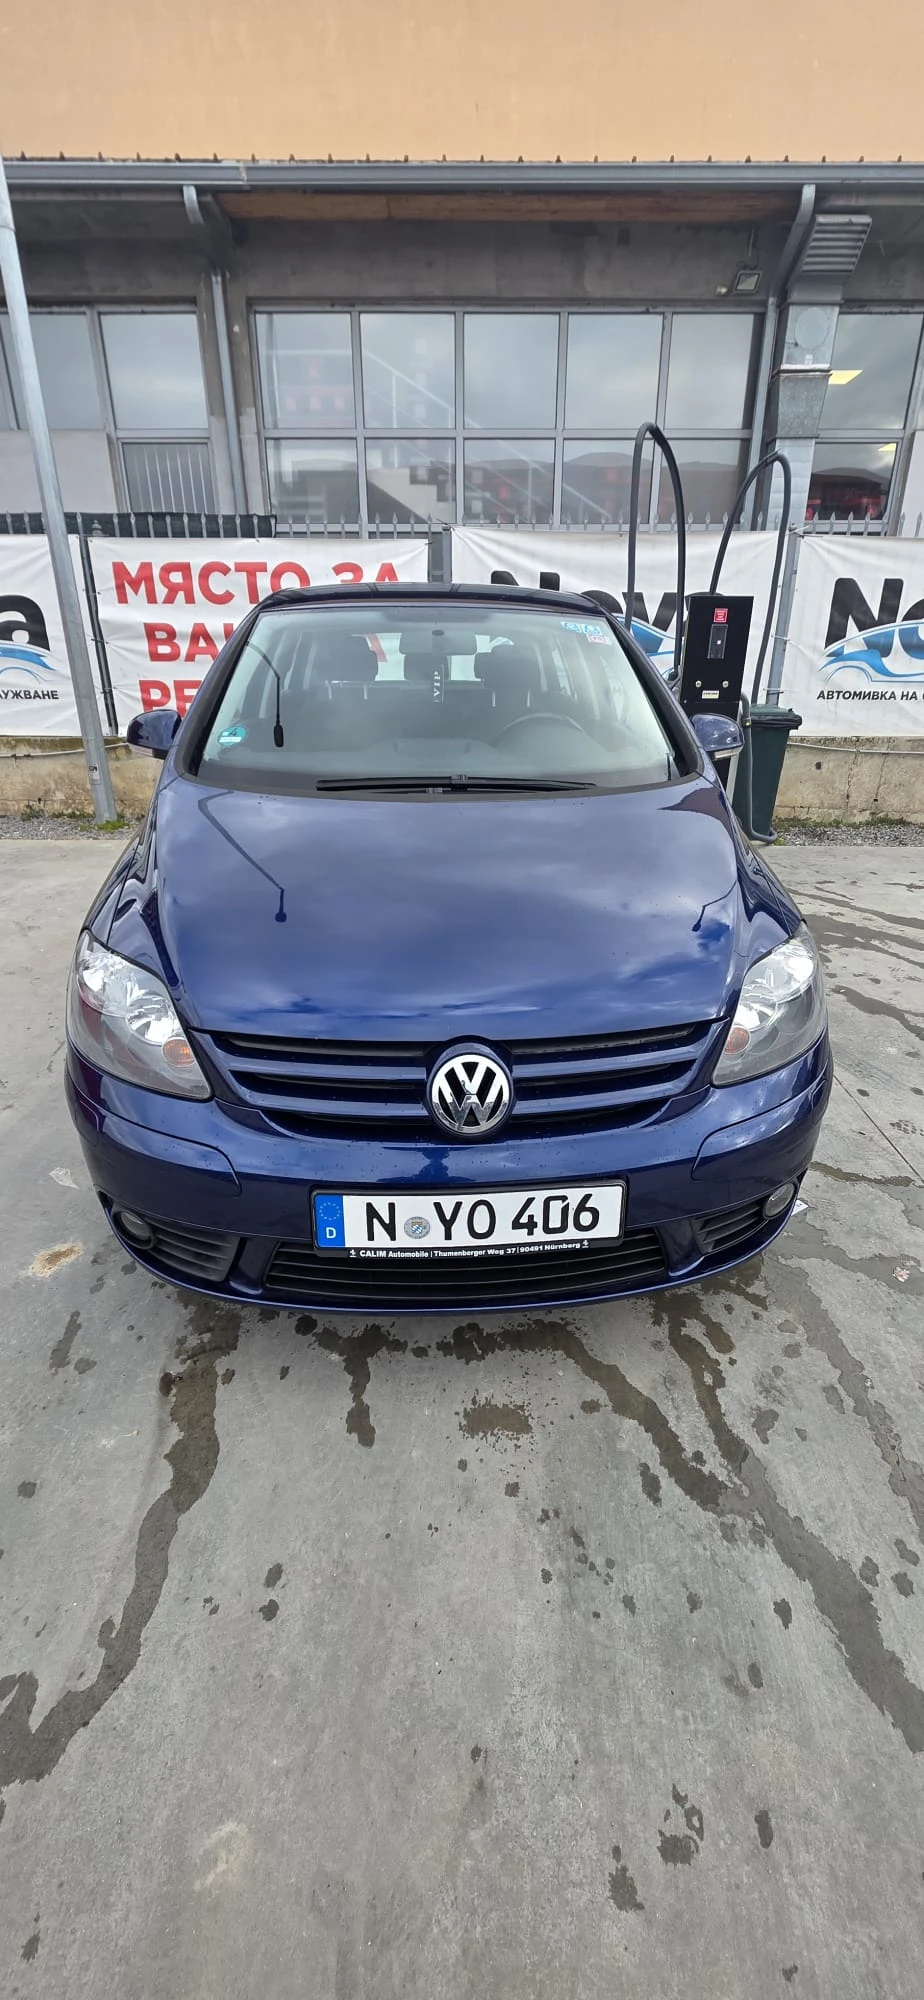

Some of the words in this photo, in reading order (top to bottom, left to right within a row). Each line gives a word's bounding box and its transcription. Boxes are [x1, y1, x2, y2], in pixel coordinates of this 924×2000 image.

[112, 561, 311, 604] МЯСТО
[143, 622, 233, 662] ВА
[0, 690, 60, 700] УЖВАНЕ
[816, 690, 897, 701] АВТОМИВКА
[900, 691, 918, 701] НА
[366, 1201, 397, 1242] N
[433, 1199, 497, 1241] YO
[511, 1193, 600, 1236] 406
[325, 1227, 337, 1239] D
[359, 1250, 387, 1258] CALIM
[388, 1250, 429, 1259] Automobile
[433, 1248, 486, 1257] Thumenberger
[487, 1247, 505, 1256] Weg
[506, 1247, 517, 1255] 37
[544, 1241, 581, 1251] Nürnberg
